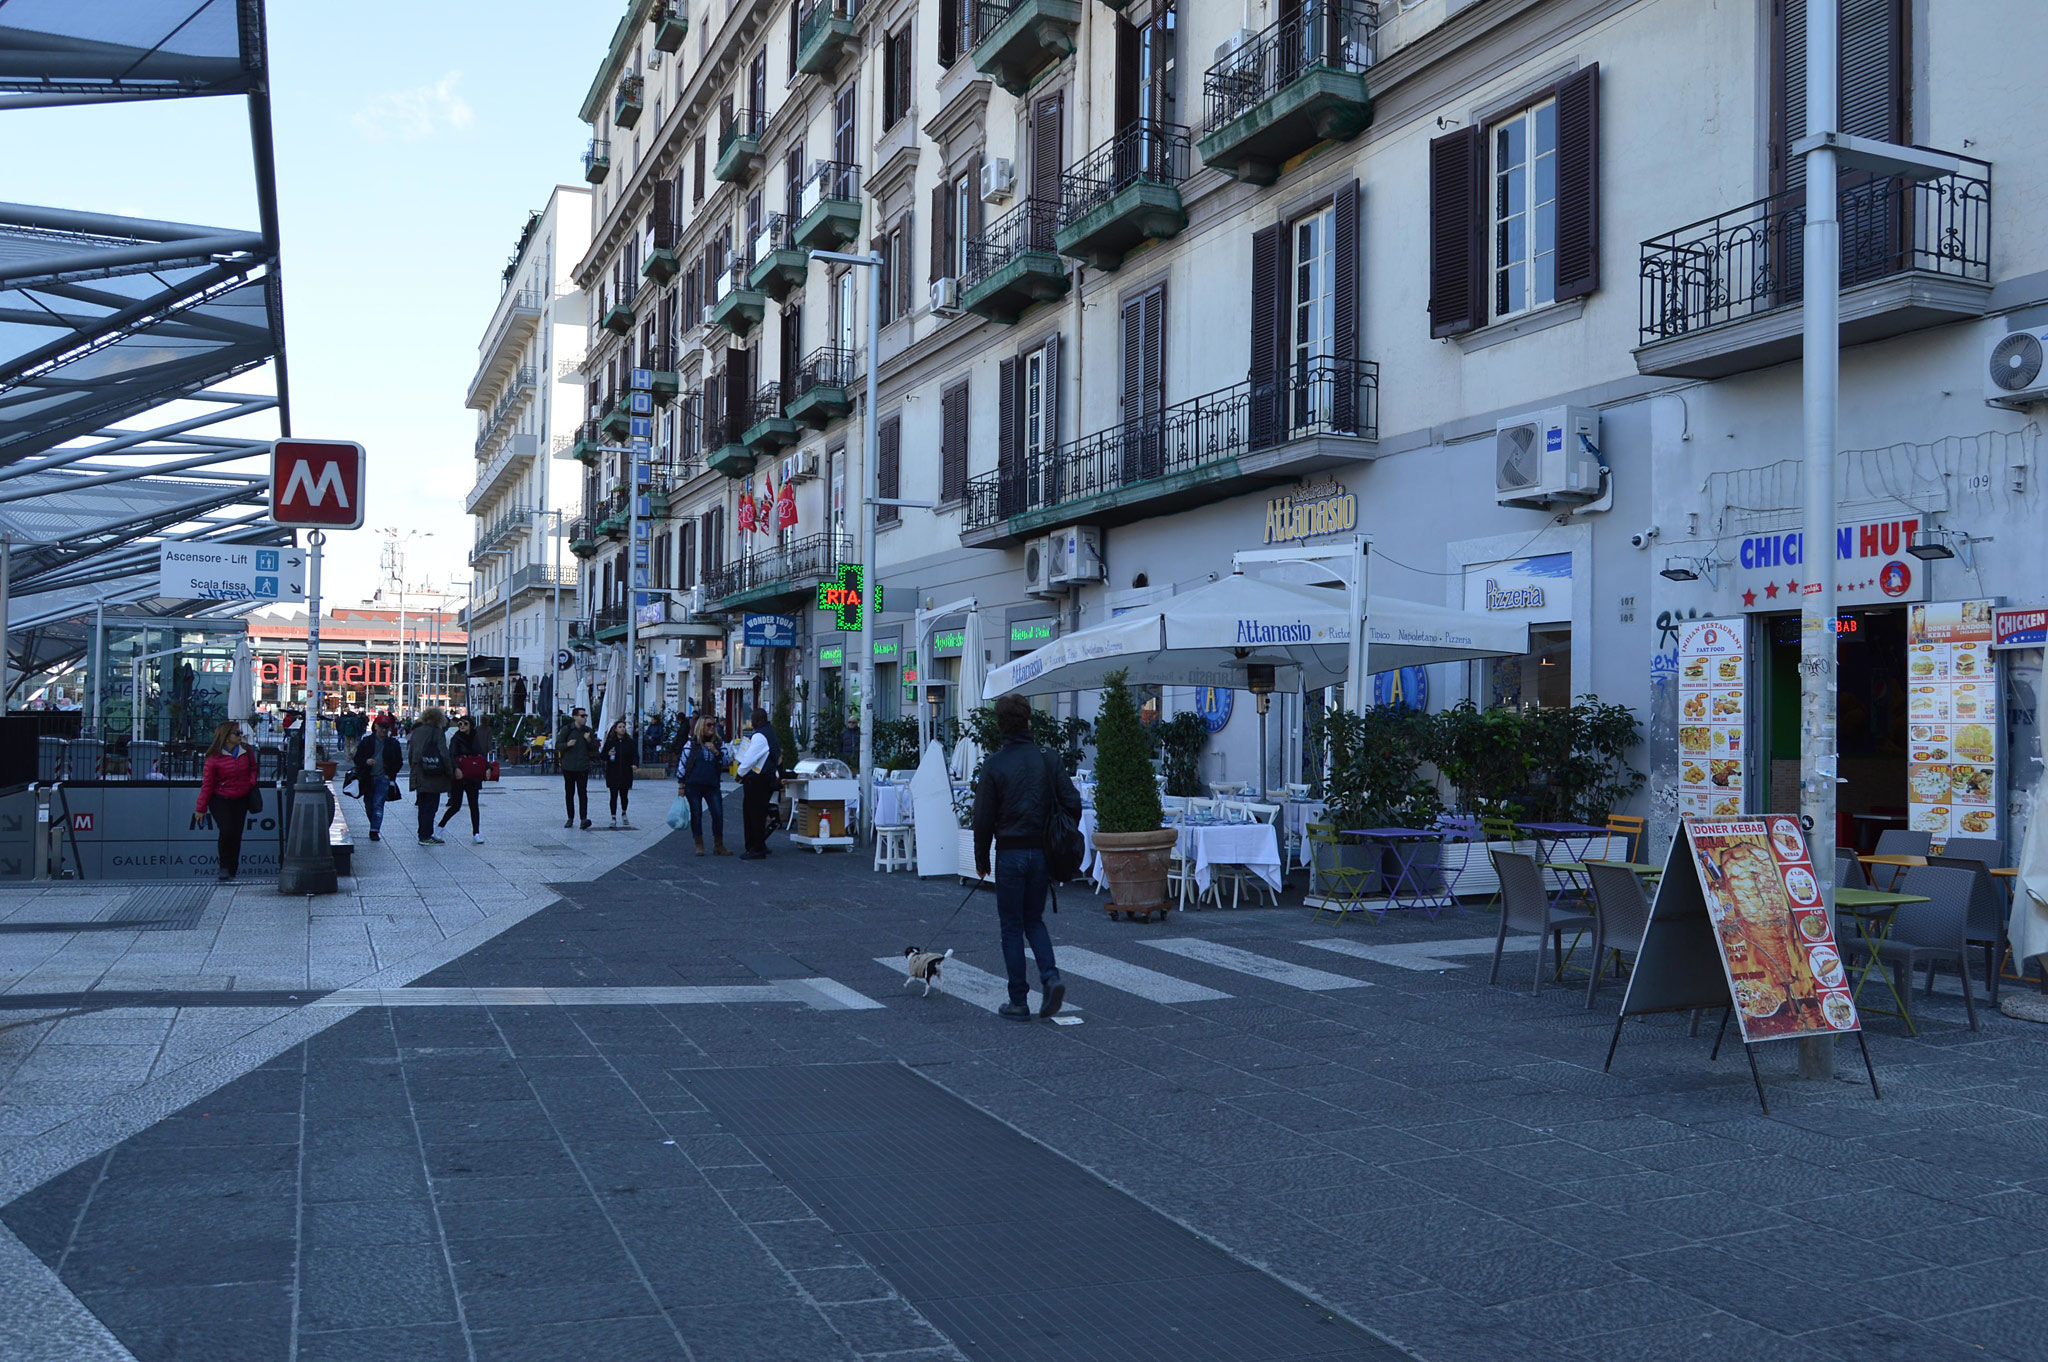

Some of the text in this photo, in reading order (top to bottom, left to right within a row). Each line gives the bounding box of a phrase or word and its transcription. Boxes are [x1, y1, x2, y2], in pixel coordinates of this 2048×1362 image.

[634, 370, 650, 484] HOTE
[1547, 437, 1561, 445] Haier
[281, 459, 350, 508] M
[1968, 474, 1989, 489] 109
[1263, 487, 1357, 543] Attanasio
[1740, 519, 1918, 569] CHICN HUT
[166, 551, 221, 563] Ascensore
[231, 554, 248, 564] Lift
[190, 579, 246, 590] Scala fissa
[1486, 579, 1542, 609] Pizzeria
[1620, 597, 1634, 606] 107
[747, 616, 794, 629] WONDER TOUR
[1836, 620, 1857, 632] BAB
[1998, 613, 2046, 636] CHICKEN
[1237, 619, 1311, 642] Attanasio
[1328, 627, 1350, 639] Risto
[1399, 629, 1438, 643] Napoletano
[1445, 632, 1472, 645] Pizzeria
[1682, 626, 1700, 653] INDIAN
[1701, 622, 1742, 650] RESTAURANT
[1012, 656, 1043, 685] Attanasio
[75, 815, 92, 828] M
[189, 812, 276, 831] Mro
[1694, 824, 1764, 835] DONER KEBAB
[1694, 836, 1730, 848] HALAL
[112, 855, 281, 866] GALLERIA COMRCIAL
